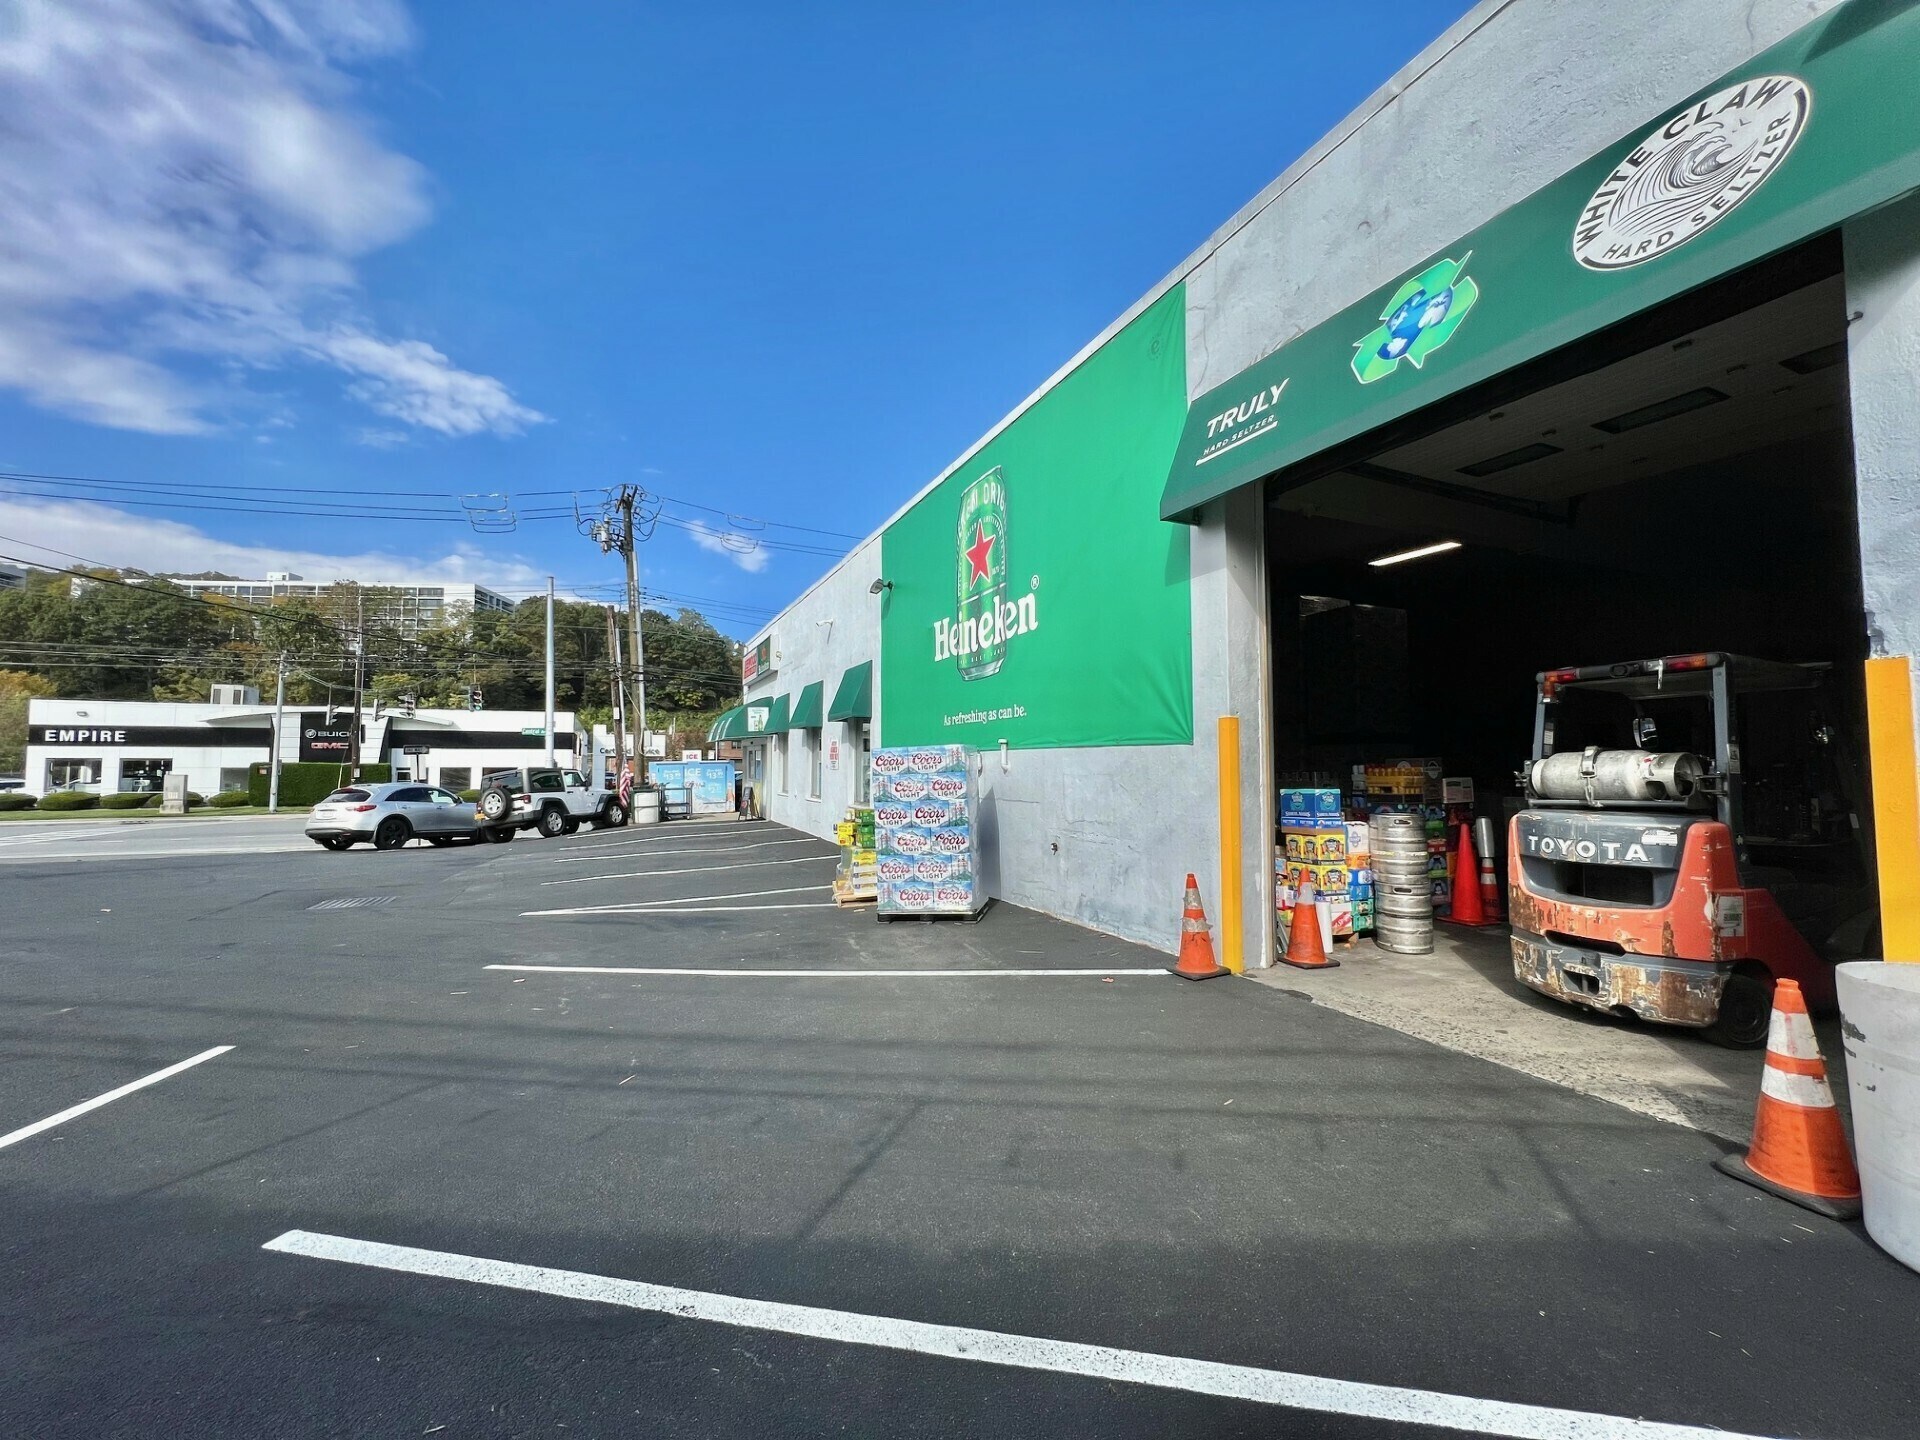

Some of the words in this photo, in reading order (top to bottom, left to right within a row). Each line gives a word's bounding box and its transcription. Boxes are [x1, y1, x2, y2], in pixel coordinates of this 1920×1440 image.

[1576, 146, 1653, 252] WHITE
[1663, 78, 1793, 140] CLAW
[1602, 230, 1674, 259] HARD
[1691, 111, 1791, 226] SELTZER
[1207, 377, 1290, 439] TRULY
[1203, 438, 1229, 456] HARD
[1231, 414, 1275, 442] SELTZER
[933, 591, 1038, 662] Heineken
[944, 714, 951, 726] As
[952, 709, 987, 725] refreshing
[988, 709, 997, 720] as
[998, 707, 1013, 719] can
[1014, 703, 1027, 717] be.
[44, 729, 126, 742] EMPIRE
[875, 755, 905, 767] Coors
[912, 752, 943, 765] Coors
[685, 767, 701, 777] ICE
[931, 779, 963, 791] Coors
[877, 807, 908, 820] Coors
[914, 806, 946, 819] Coors
[1528, 835, 1650, 862] TOYOTA
[880, 862, 911, 874] Coors
[917, 861, 949, 874] Coors
[899, 889, 930, 901] Coors
[937, 887, 969, 900] Coors
